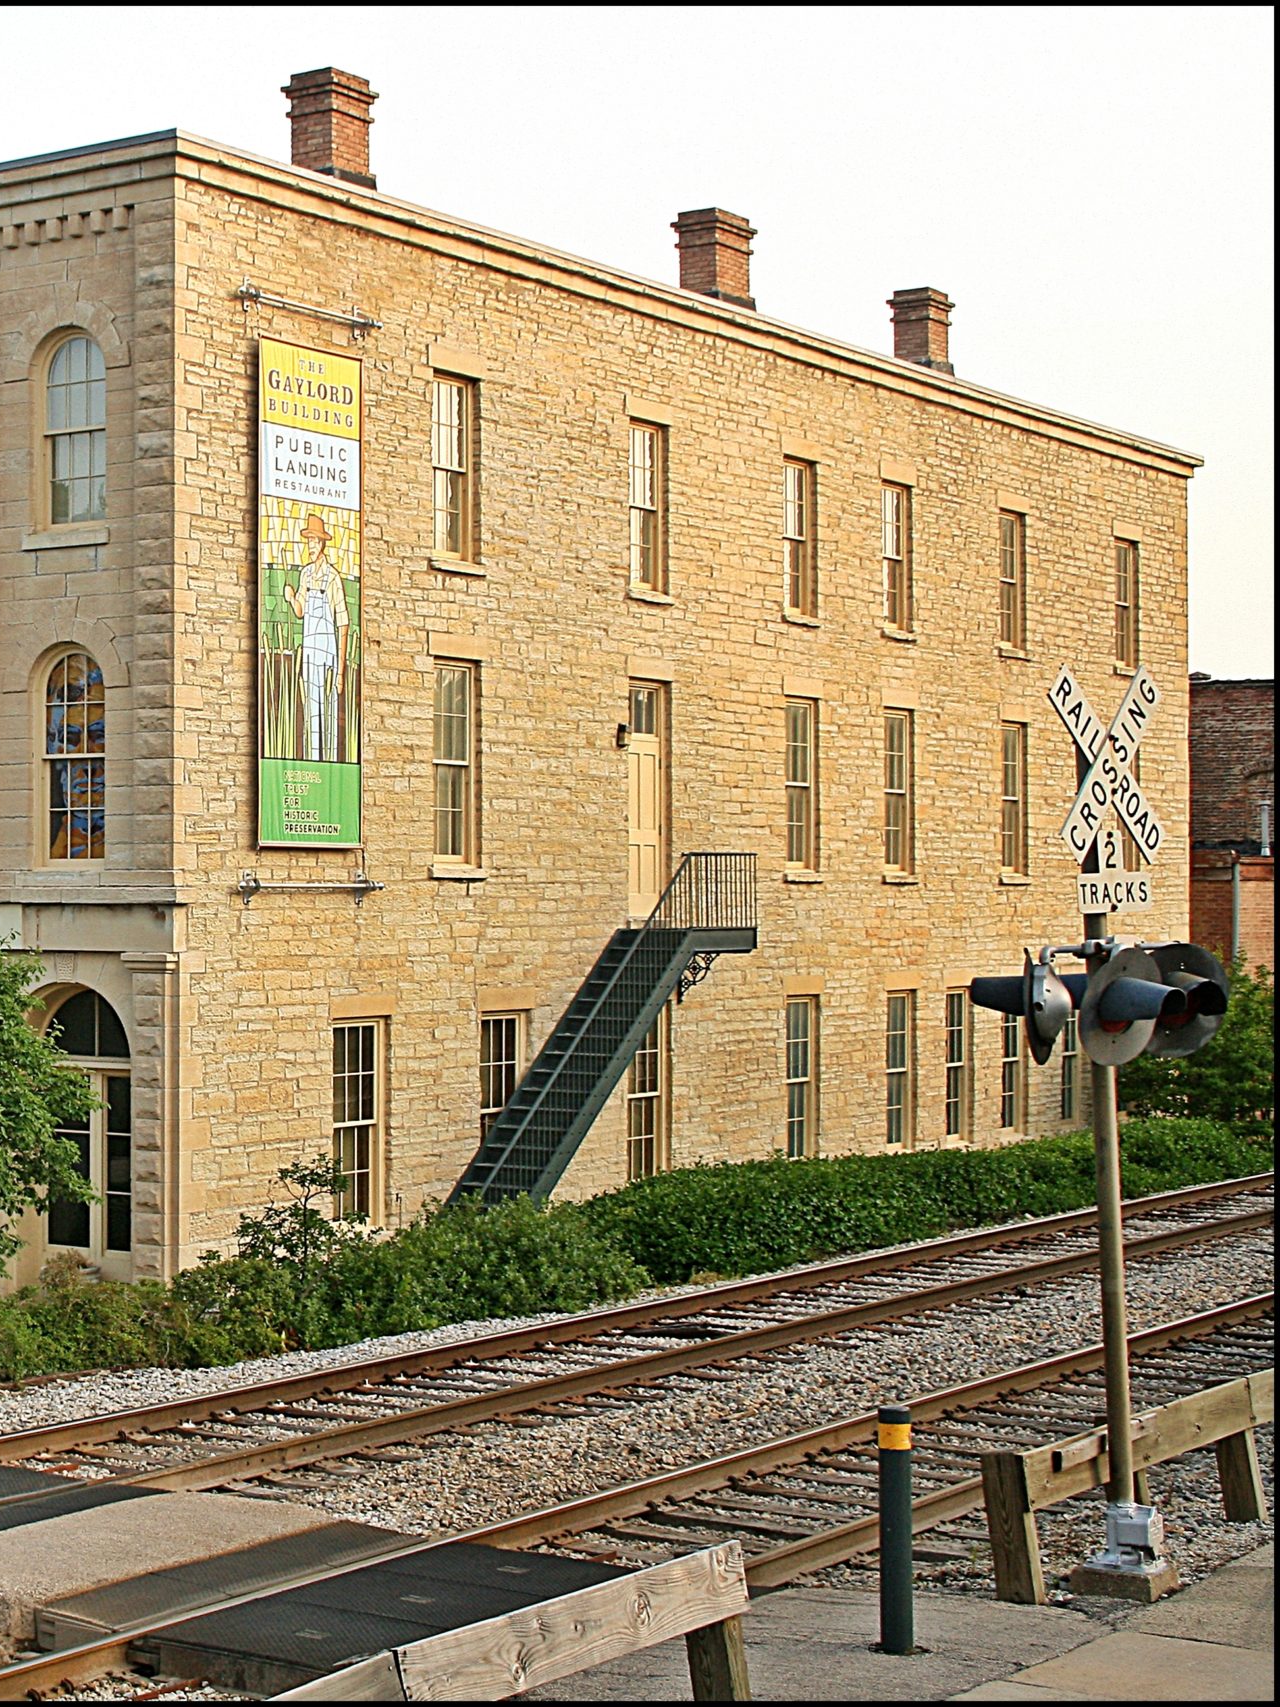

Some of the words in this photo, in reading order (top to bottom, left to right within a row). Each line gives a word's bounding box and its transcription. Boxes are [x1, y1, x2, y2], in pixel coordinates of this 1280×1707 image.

[299, 359, 325, 375] THE
[268, 369, 354, 406] GAYLORD
[268, 398, 354, 428] BUILDING
[275, 435, 347, 462] PUBLIC
[275, 457, 347, 483] LANDING
[275, 478, 347, 500] RESTAURANT
[284, 770, 322, 783] NATIONAL
[1070, 678, 1156, 852] CROSSING
[284, 784, 308, 795] TRUST
[284, 797, 300, 808] FOR
[284, 810, 318, 821] HISTORIC
[284, 823, 339, 835] PRESERVATION
[1104, 840, 1117, 869] 2
[1080, 881, 1148, 905] TRACKS
